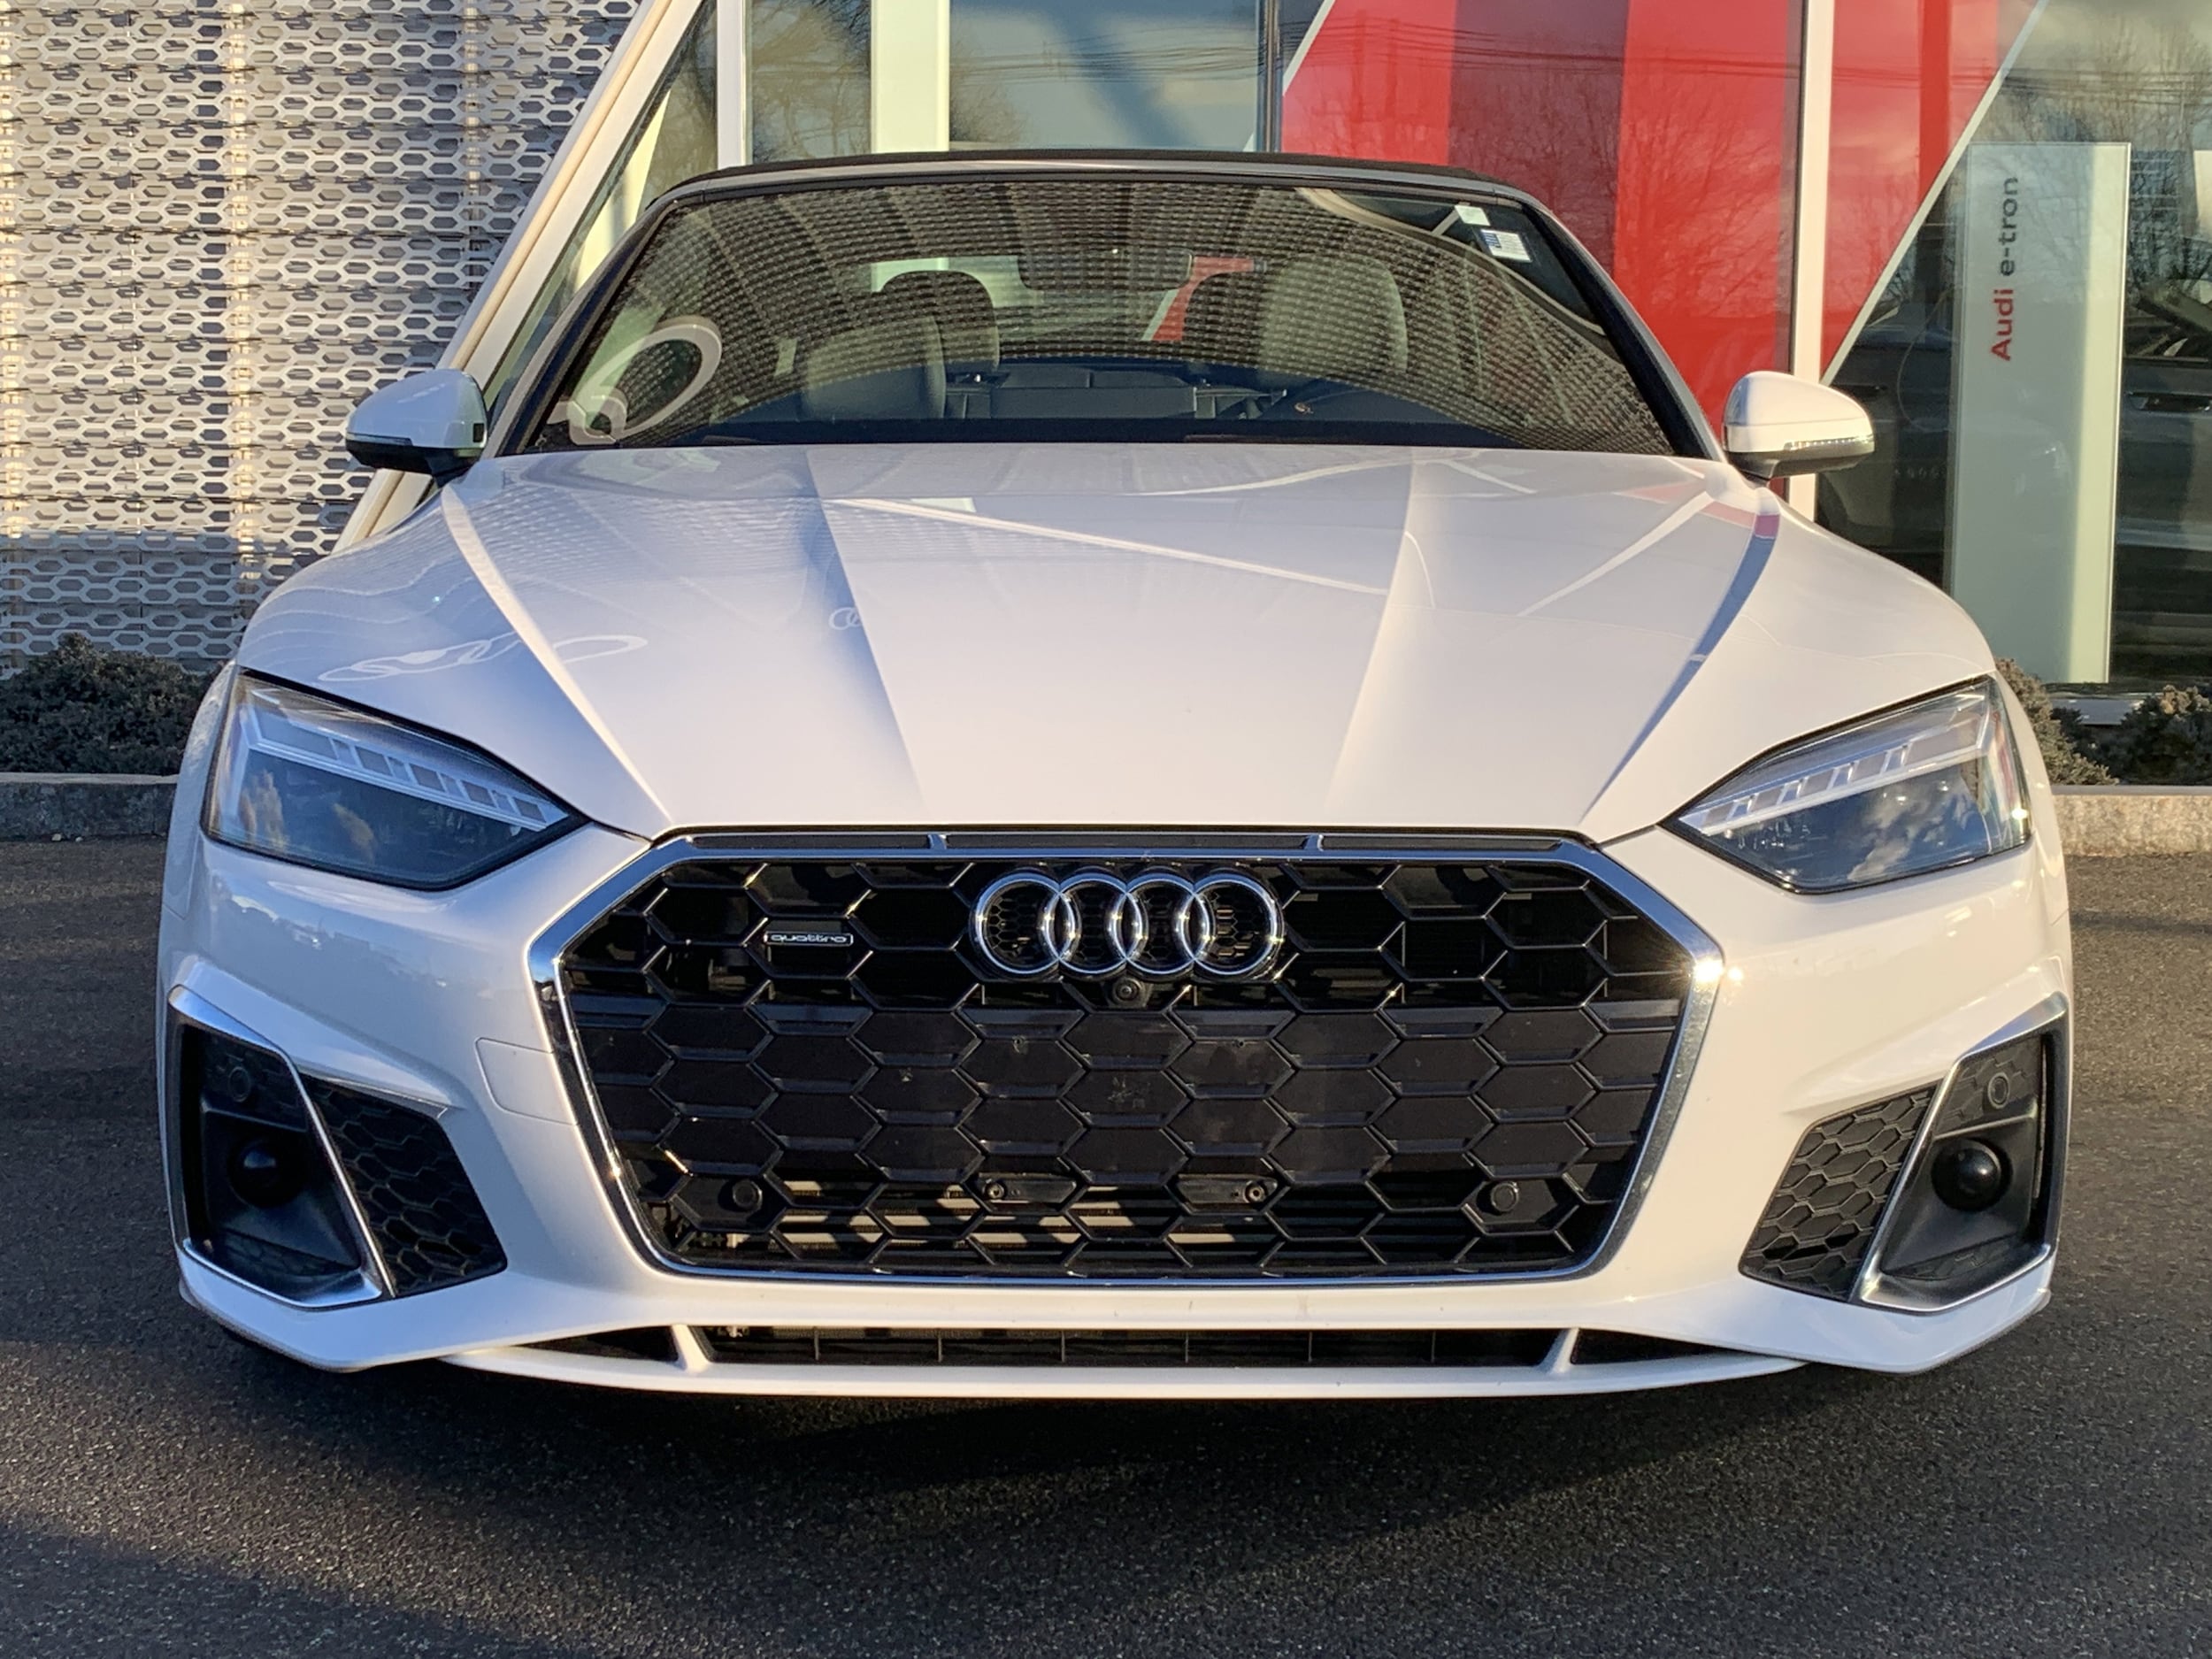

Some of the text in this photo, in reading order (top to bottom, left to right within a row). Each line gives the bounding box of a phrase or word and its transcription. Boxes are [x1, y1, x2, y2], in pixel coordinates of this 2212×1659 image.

[1991, 177, 2018, 361] Audi e-tron
[771, 933, 848, 943] quattro
